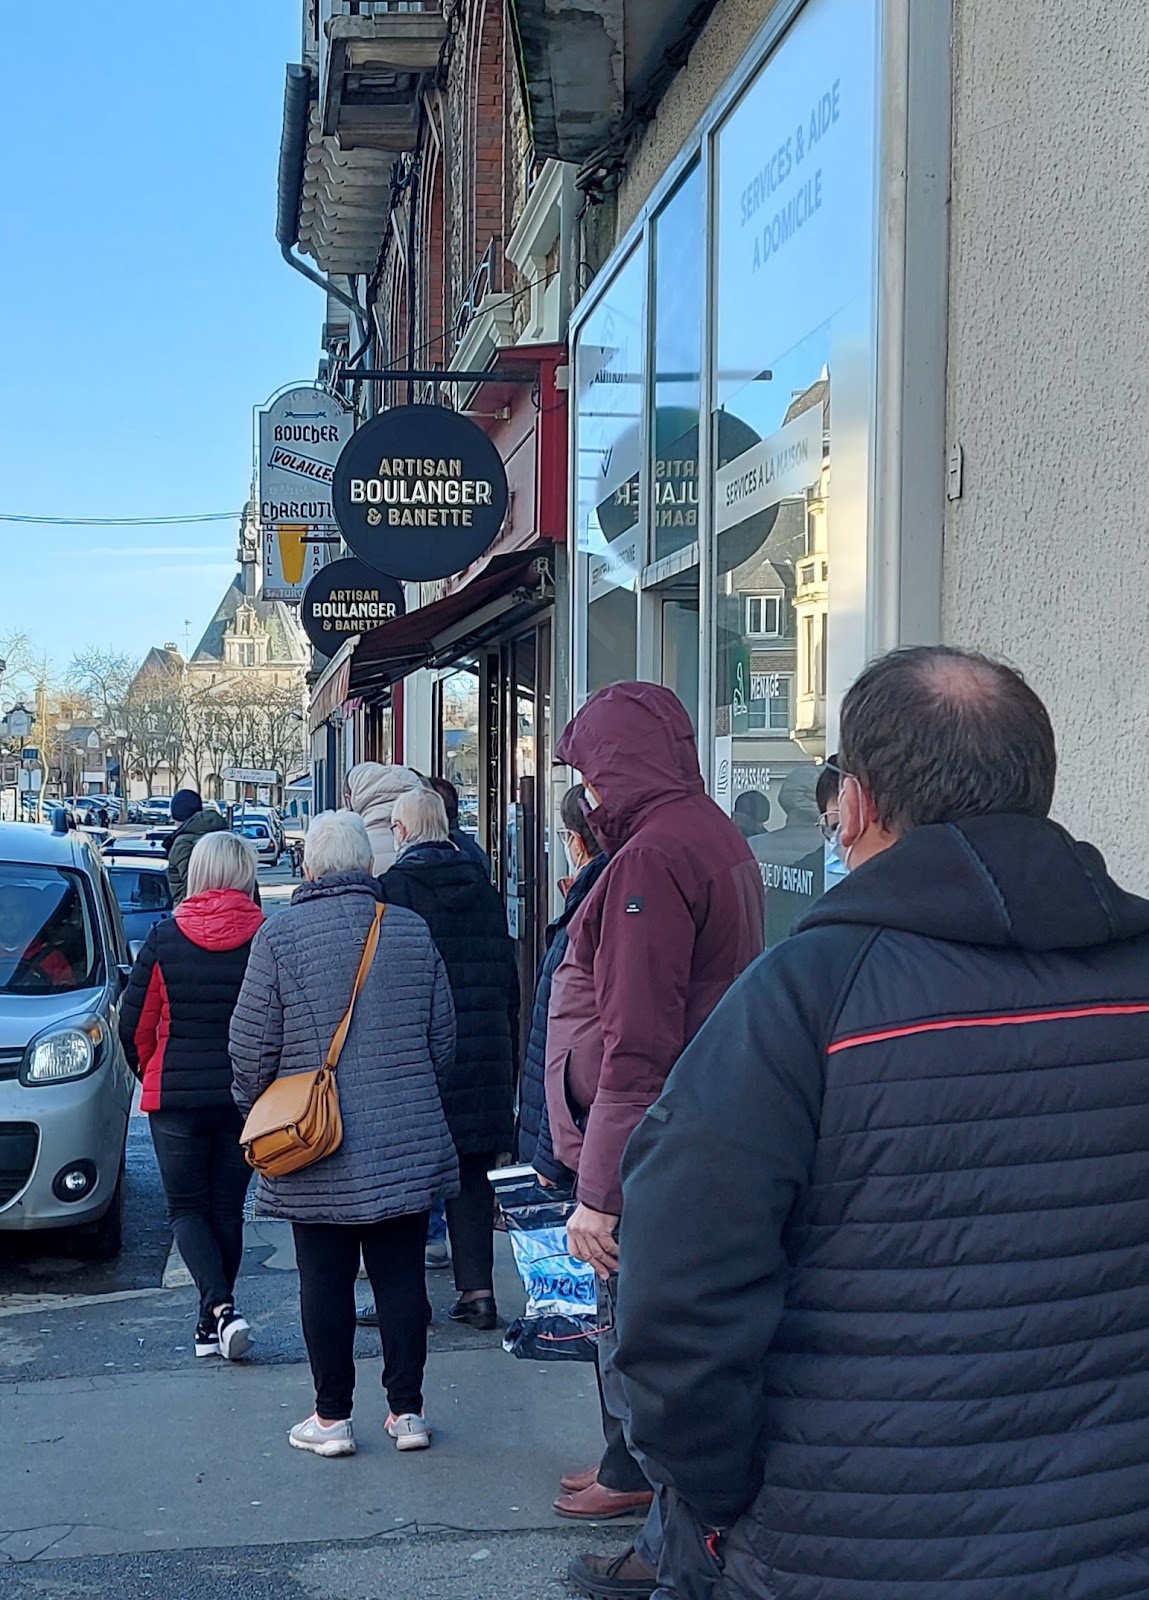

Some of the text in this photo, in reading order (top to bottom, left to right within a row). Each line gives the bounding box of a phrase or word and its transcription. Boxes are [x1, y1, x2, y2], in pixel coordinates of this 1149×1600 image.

[740, 78, 841, 227] SERVICES & AIDE
[752, 168, 822, 275] A DOMICILE
[379, 458, 462, 476] ARTISAN
[726, 437, 809, 507] SERVICES A LA MAISON
[350, 479, 492, 505] BOULANGER
[366, 507, 473, 526] & BANETTE
[329, 590, 379, 601] ARTISAN
[312, 602, 396, 618] BOULANGER
[322, 620, 332, 631] &
[733, 767, 770, 791] REPASSAGE
[782, 866, 814, 896] ENFANT
